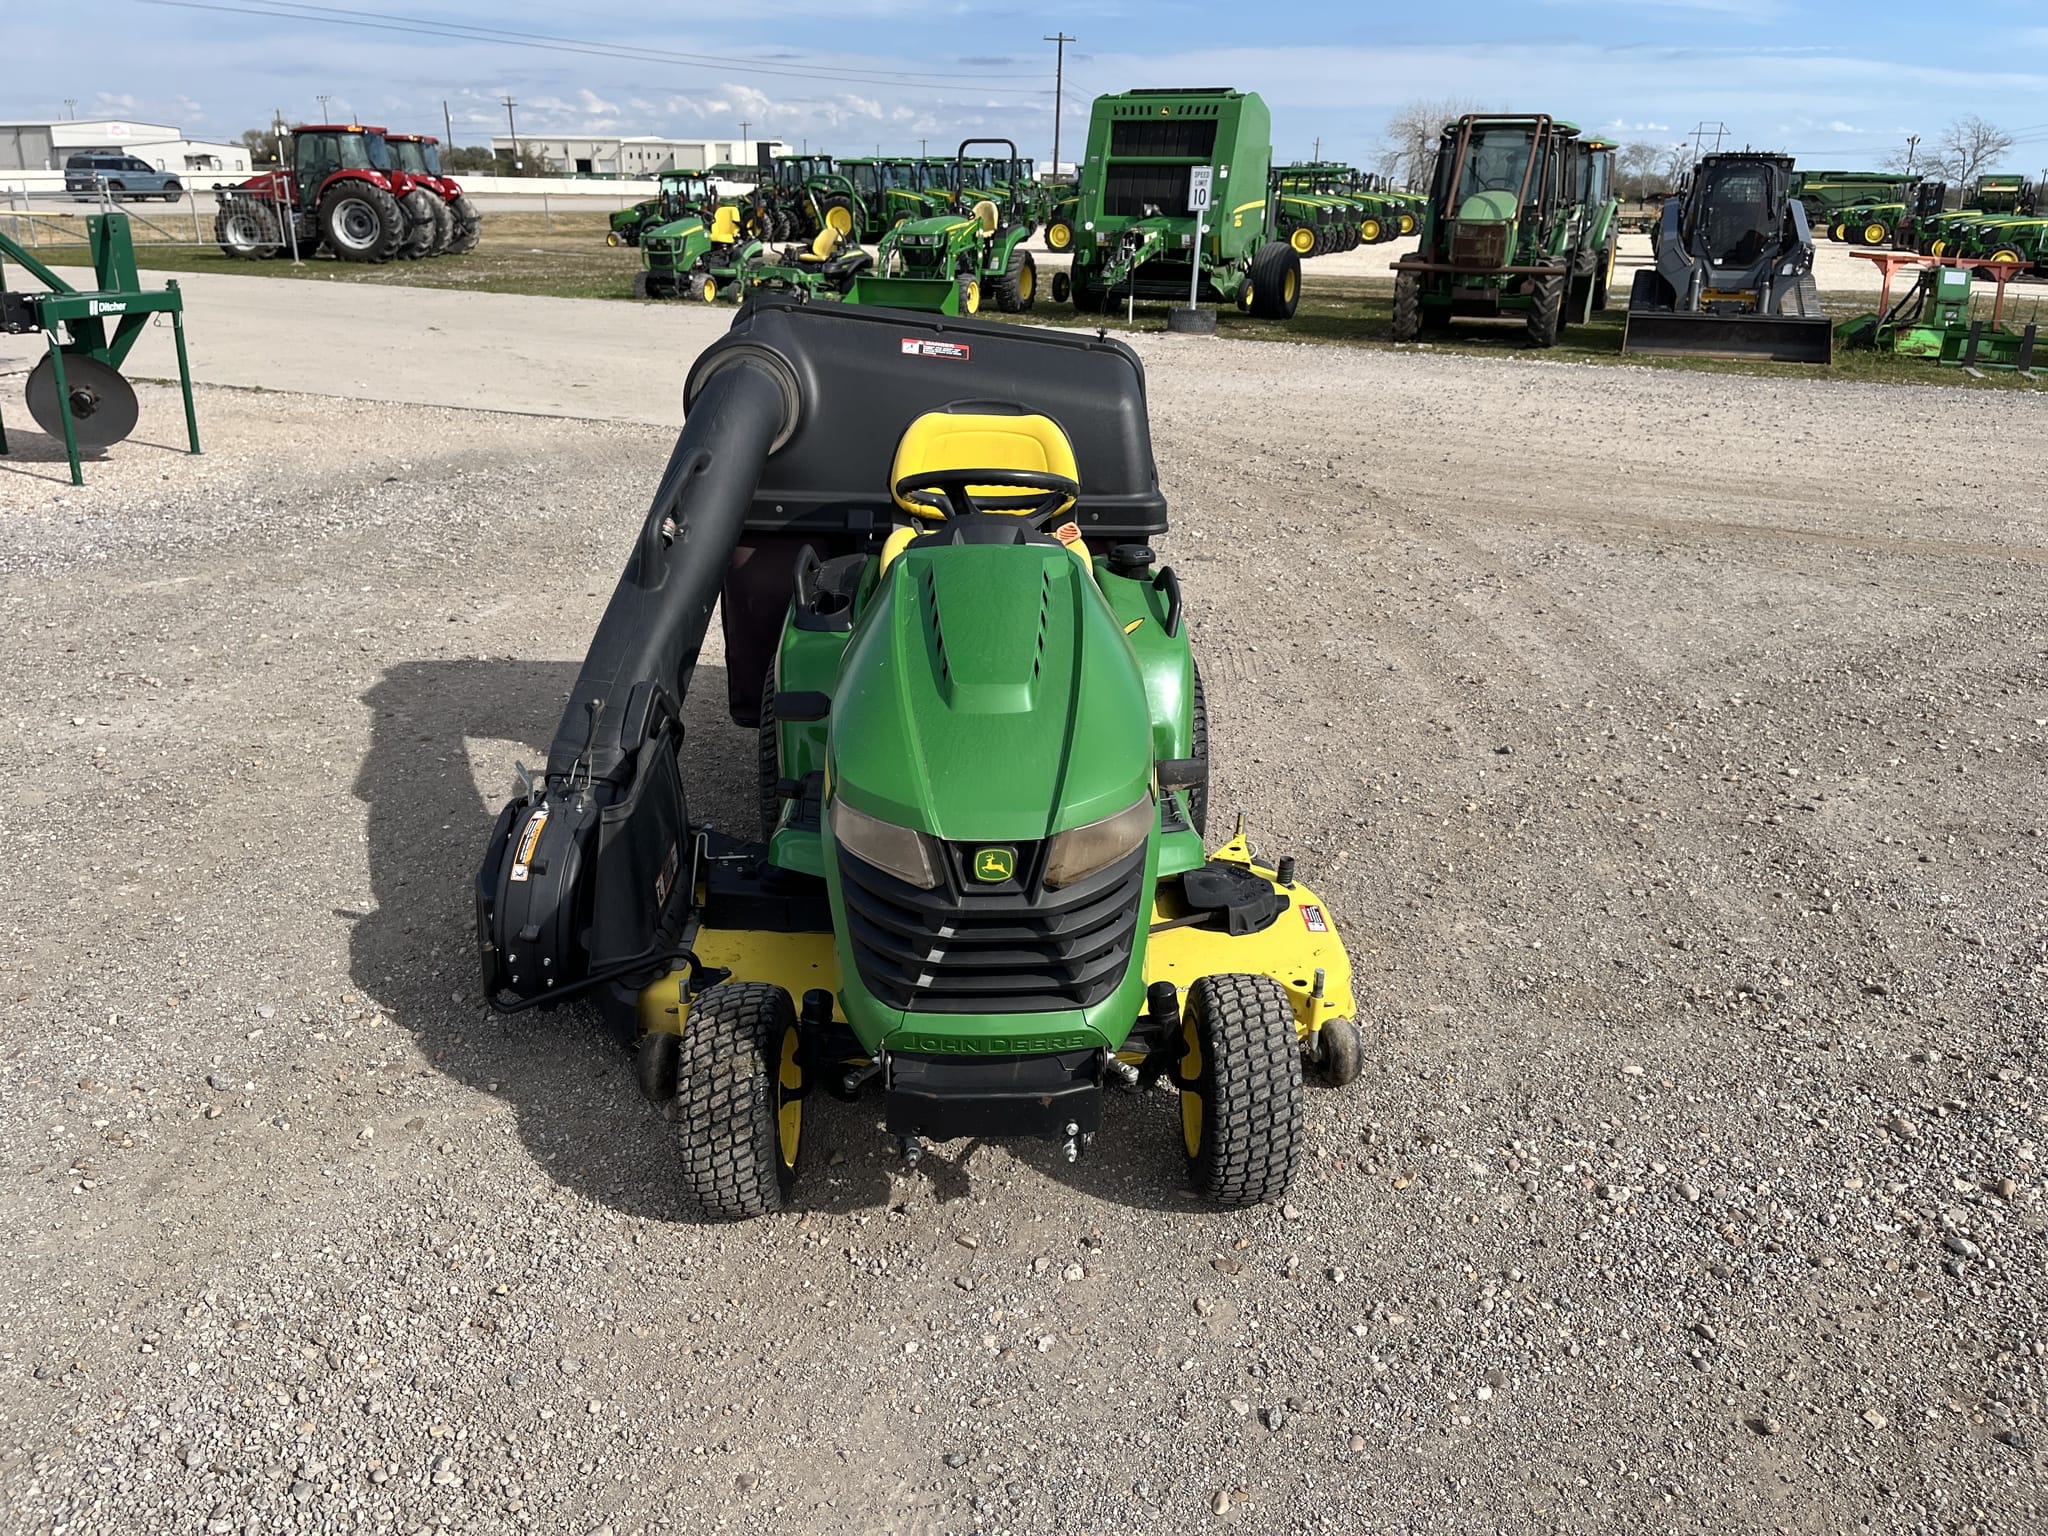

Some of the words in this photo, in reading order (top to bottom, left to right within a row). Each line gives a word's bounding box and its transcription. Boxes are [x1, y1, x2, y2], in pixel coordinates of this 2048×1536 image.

[1194, 188, 1207, 205] 10
[98, 301, 127, 312] Ditcher
[904, 1035, 981, 1053] JOHN
[988, 1036, 1085, 1053] DEERE
